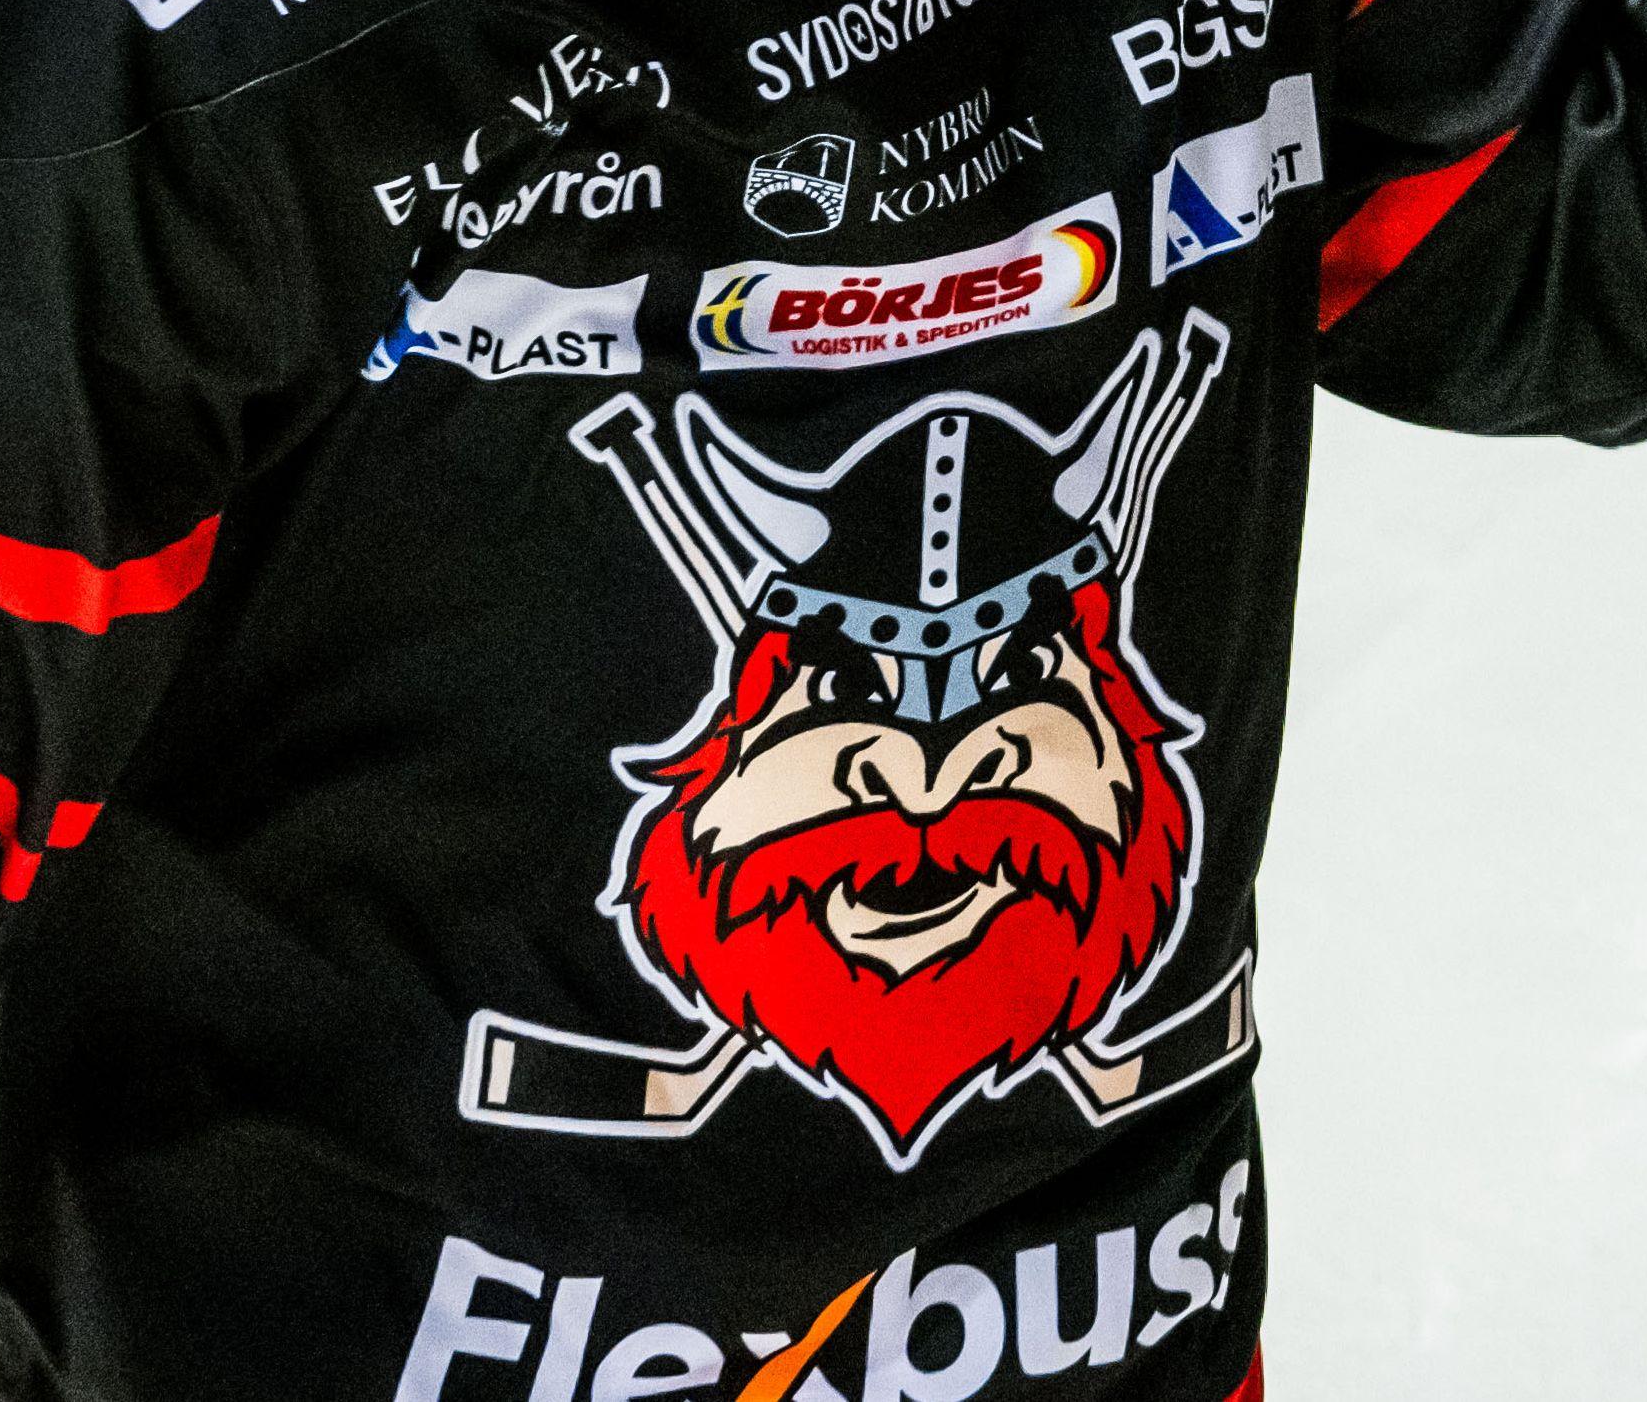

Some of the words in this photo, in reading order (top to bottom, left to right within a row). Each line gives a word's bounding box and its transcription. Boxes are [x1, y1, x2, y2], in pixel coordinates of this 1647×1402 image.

[870, 115, 1044, 222] KOMMUN
[878, 86, 992, 175] NYBRO
[768, 253, 1044, 333] BÖRJES
[791, 332, 888, 356] LOGISTIK
[895, 331, 909, 348] &
[916, 302, 1031, 346] SPEDITION
